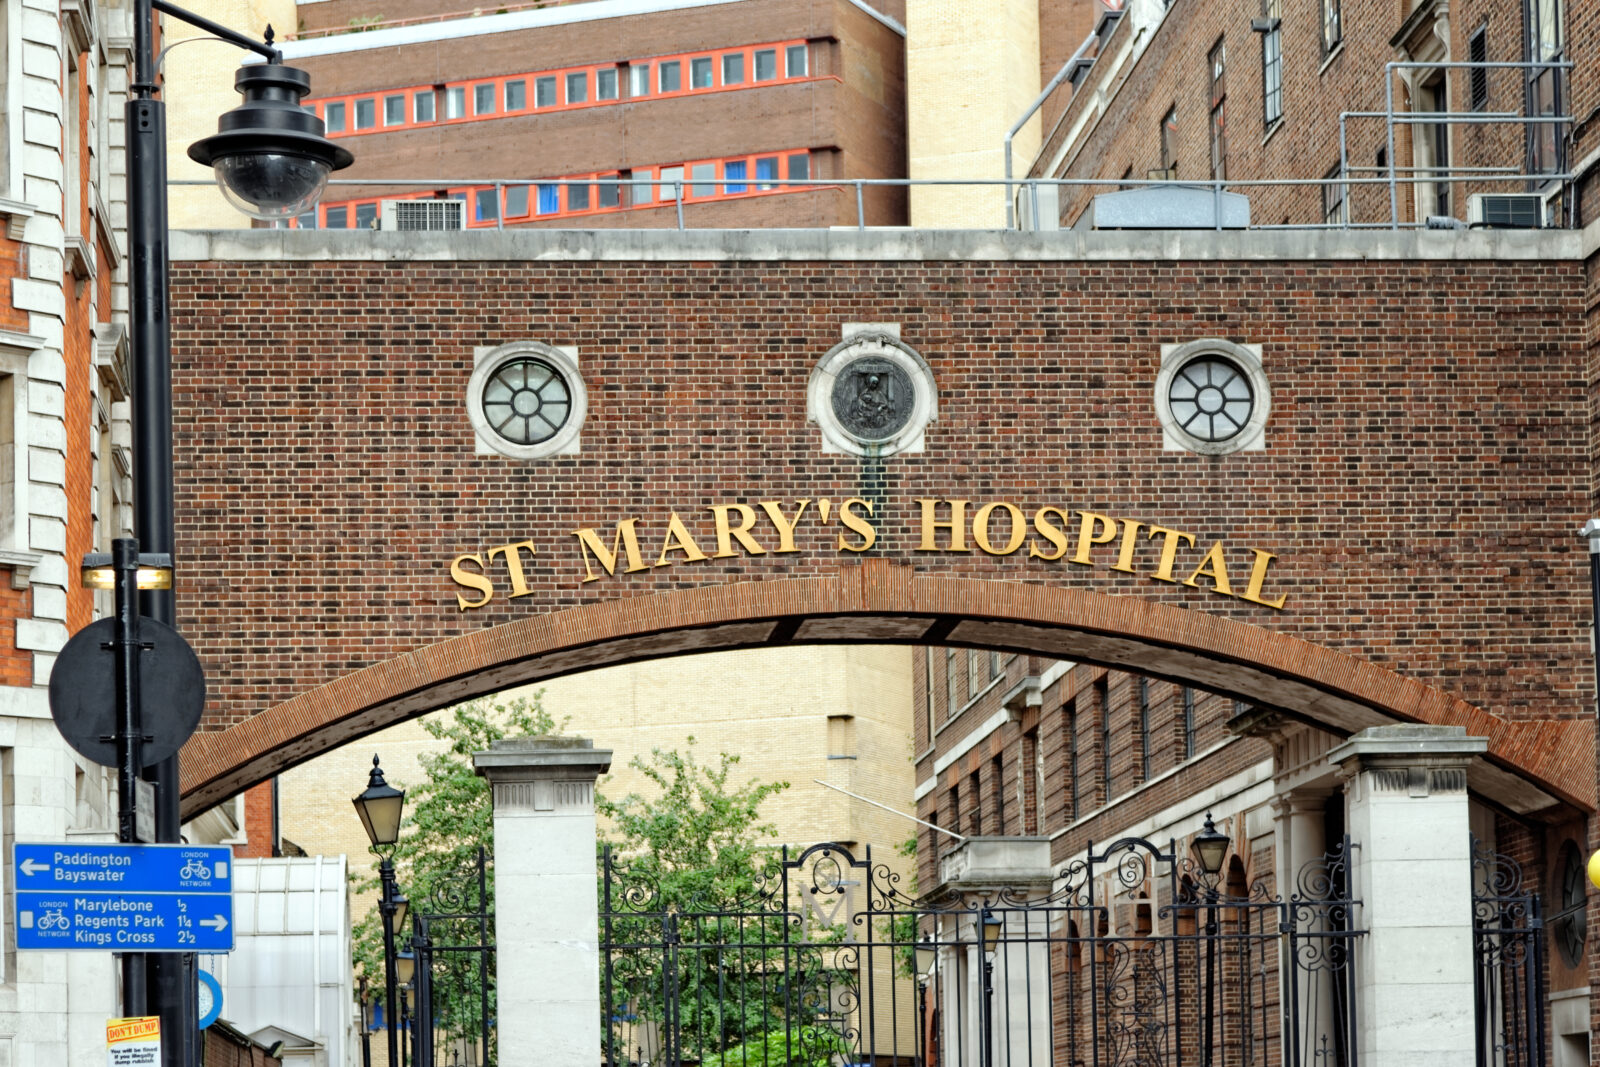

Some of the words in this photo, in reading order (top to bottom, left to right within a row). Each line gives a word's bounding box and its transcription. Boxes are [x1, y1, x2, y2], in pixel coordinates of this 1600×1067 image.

[450, 540, 536, 612] ST
[571, 498, 877, 583] MARY'S
[914, 498, 1289, 611] HOSPITAL
[54, 852, 131, 868] Paddington
[54, 868, 125, 883] Bayswater
[74, 898, 153, 914] Marylebone
[74, 914, 129, 929] Regents
[134, 914, 165, 927] Park
[75, 930, 112, 945] Kings
[116, 930, 156, 943] Cross
[109, 1026, 132, 1039] DON'T
[133, 1022, 156, 1034] DUMP
